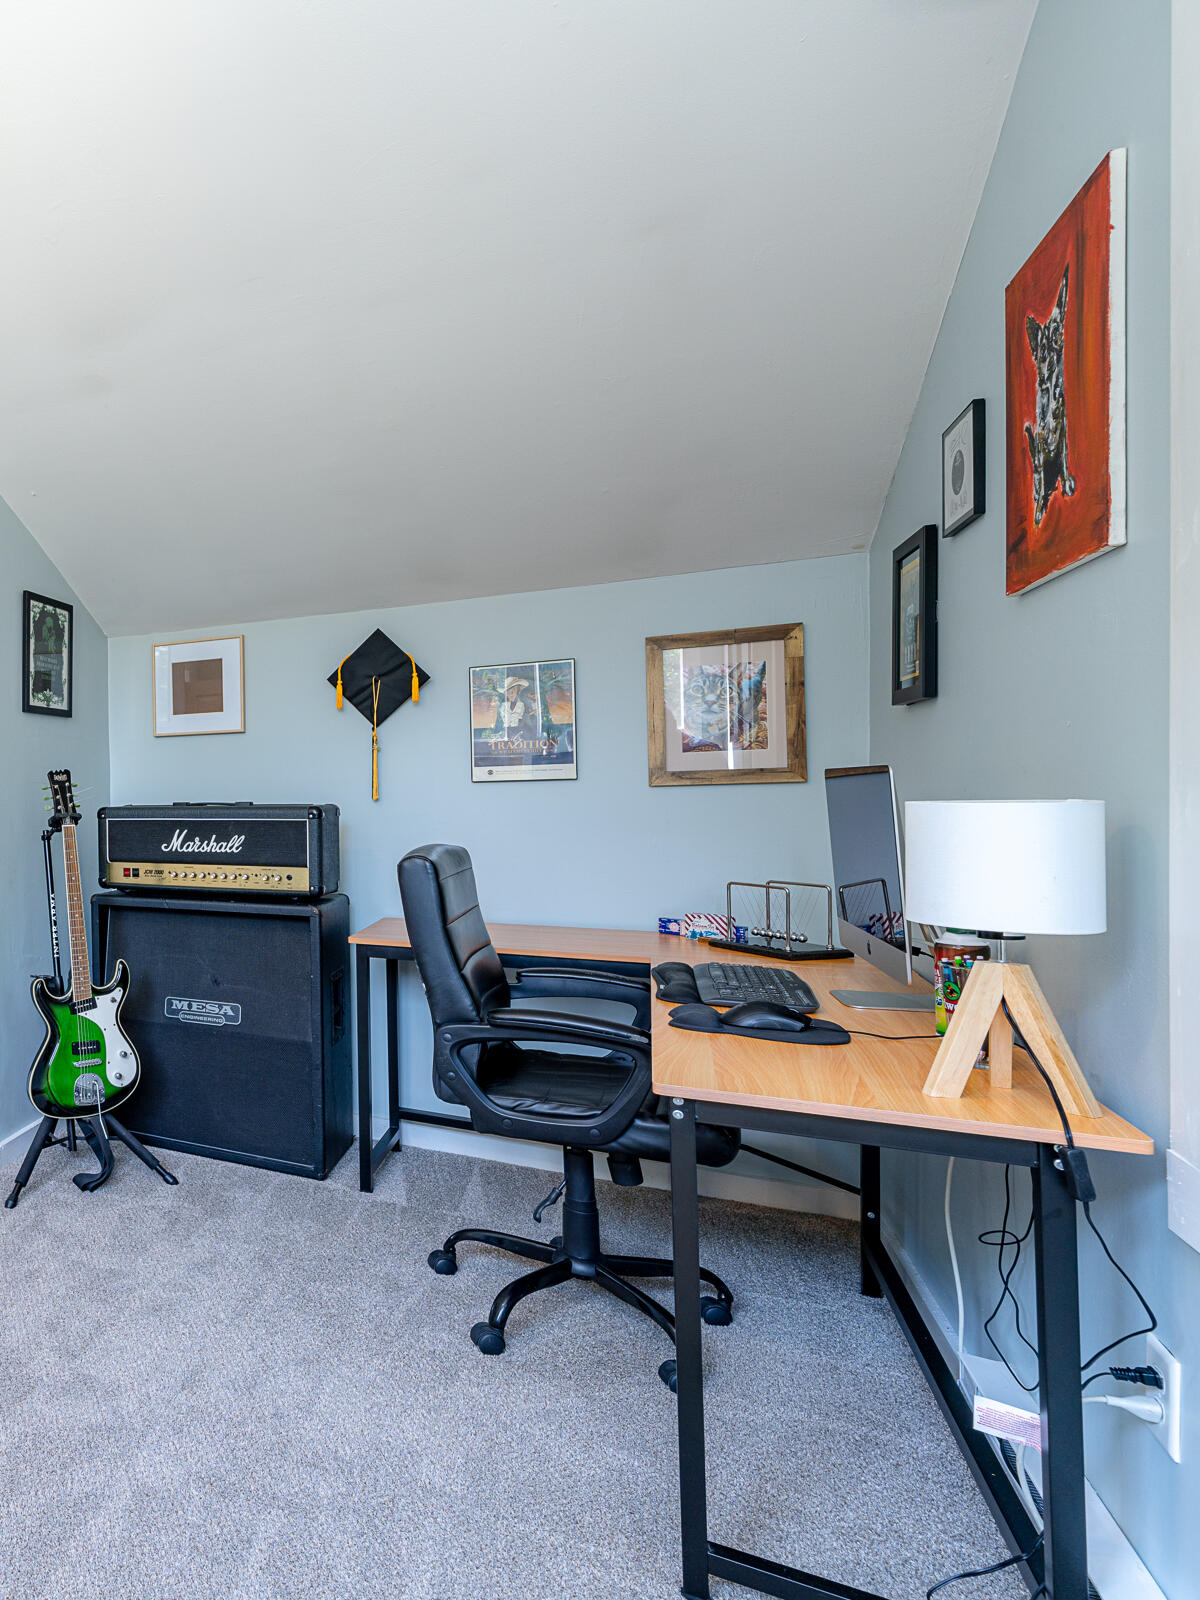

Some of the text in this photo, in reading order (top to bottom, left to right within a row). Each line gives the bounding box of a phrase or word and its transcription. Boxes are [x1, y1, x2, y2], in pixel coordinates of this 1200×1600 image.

[488, 739, 558, 750] TRADITION
[161, 829, 245, 853] Marshall
[170, 1000, 235, 1016] MESA
[181, 1014, 223, 1023] ENGINEERING
